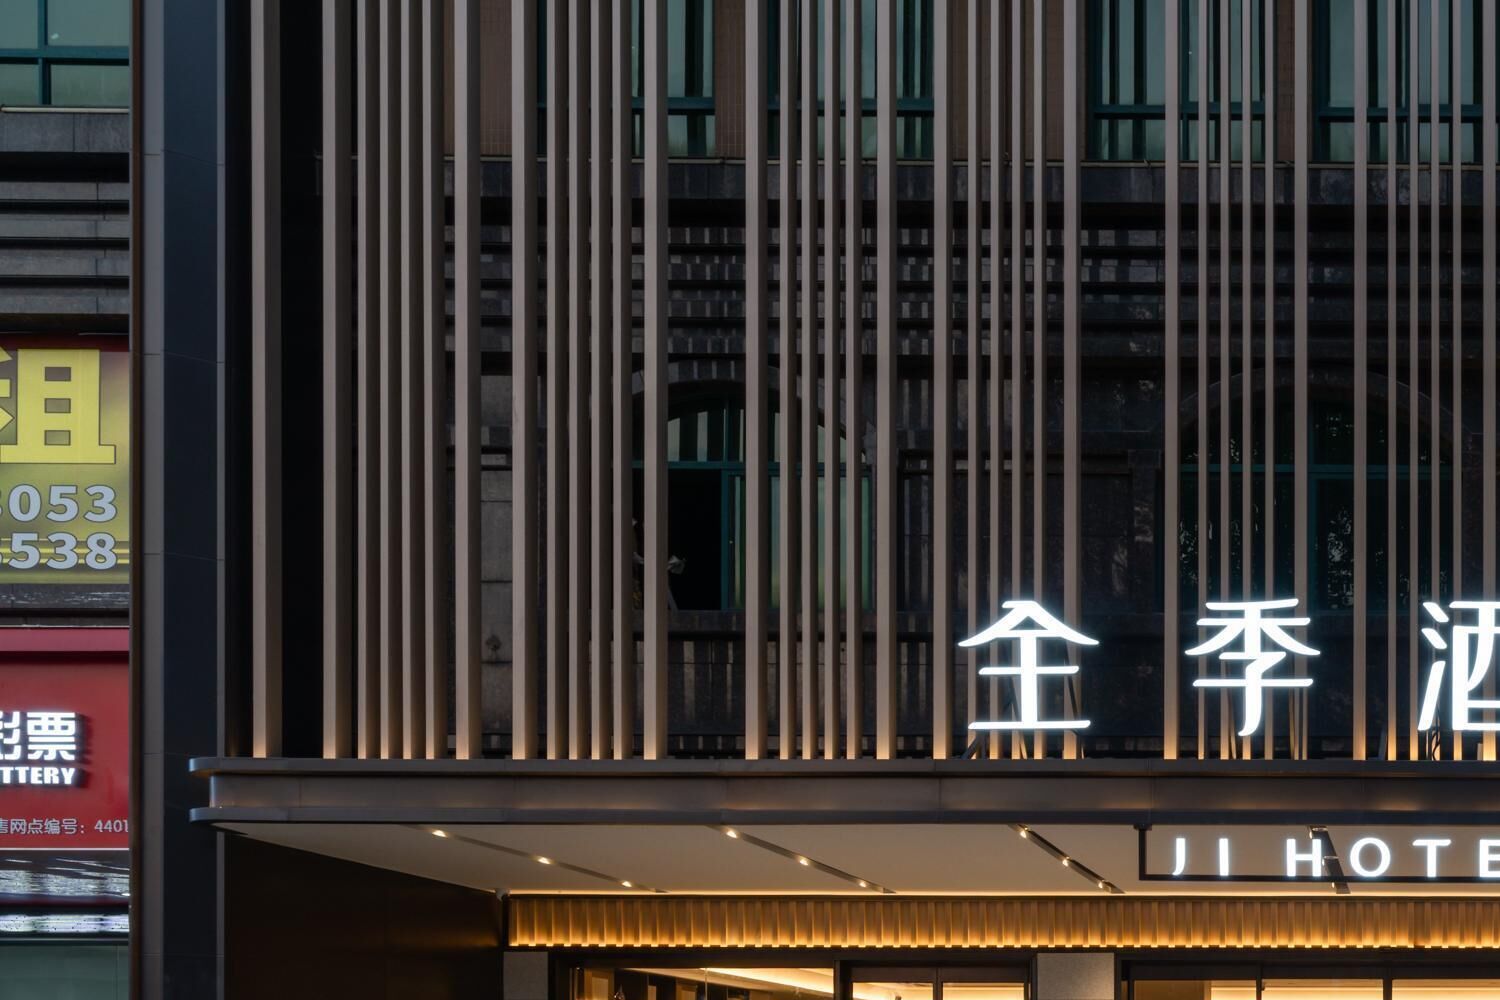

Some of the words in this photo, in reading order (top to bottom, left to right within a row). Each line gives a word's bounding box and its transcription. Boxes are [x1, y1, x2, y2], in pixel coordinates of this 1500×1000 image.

[0, 484, 118, 522] 053
[0, 532, 118, 570] 538
[1172, 837, 1230, 877] JI
